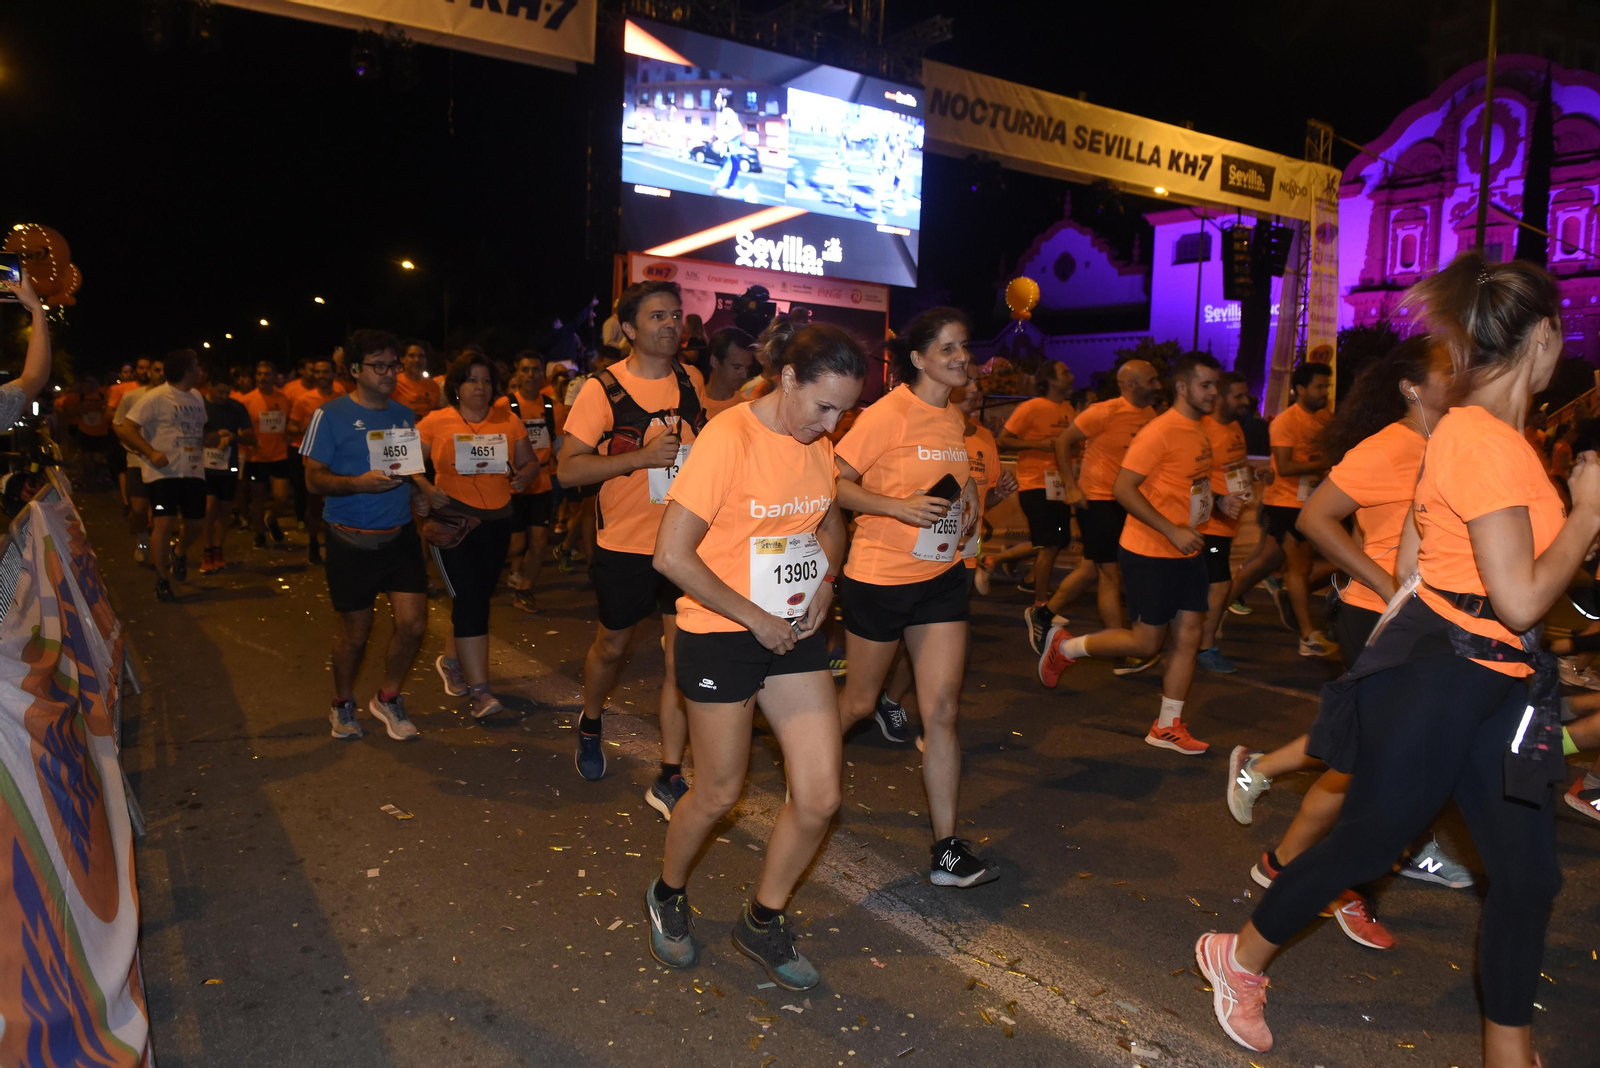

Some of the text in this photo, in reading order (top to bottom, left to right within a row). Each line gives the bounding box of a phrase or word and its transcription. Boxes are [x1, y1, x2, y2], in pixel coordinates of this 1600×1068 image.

[928, 88, 1067, 145] NOCTURNA
[1073, 125, 1161, 168] SEVILLA
[383, 445, 407, 457] 4650
[471, 446, 495, 456] 4651
[932, 518, 957, 534] 12655
[773, 560, 818, 585] 13903
